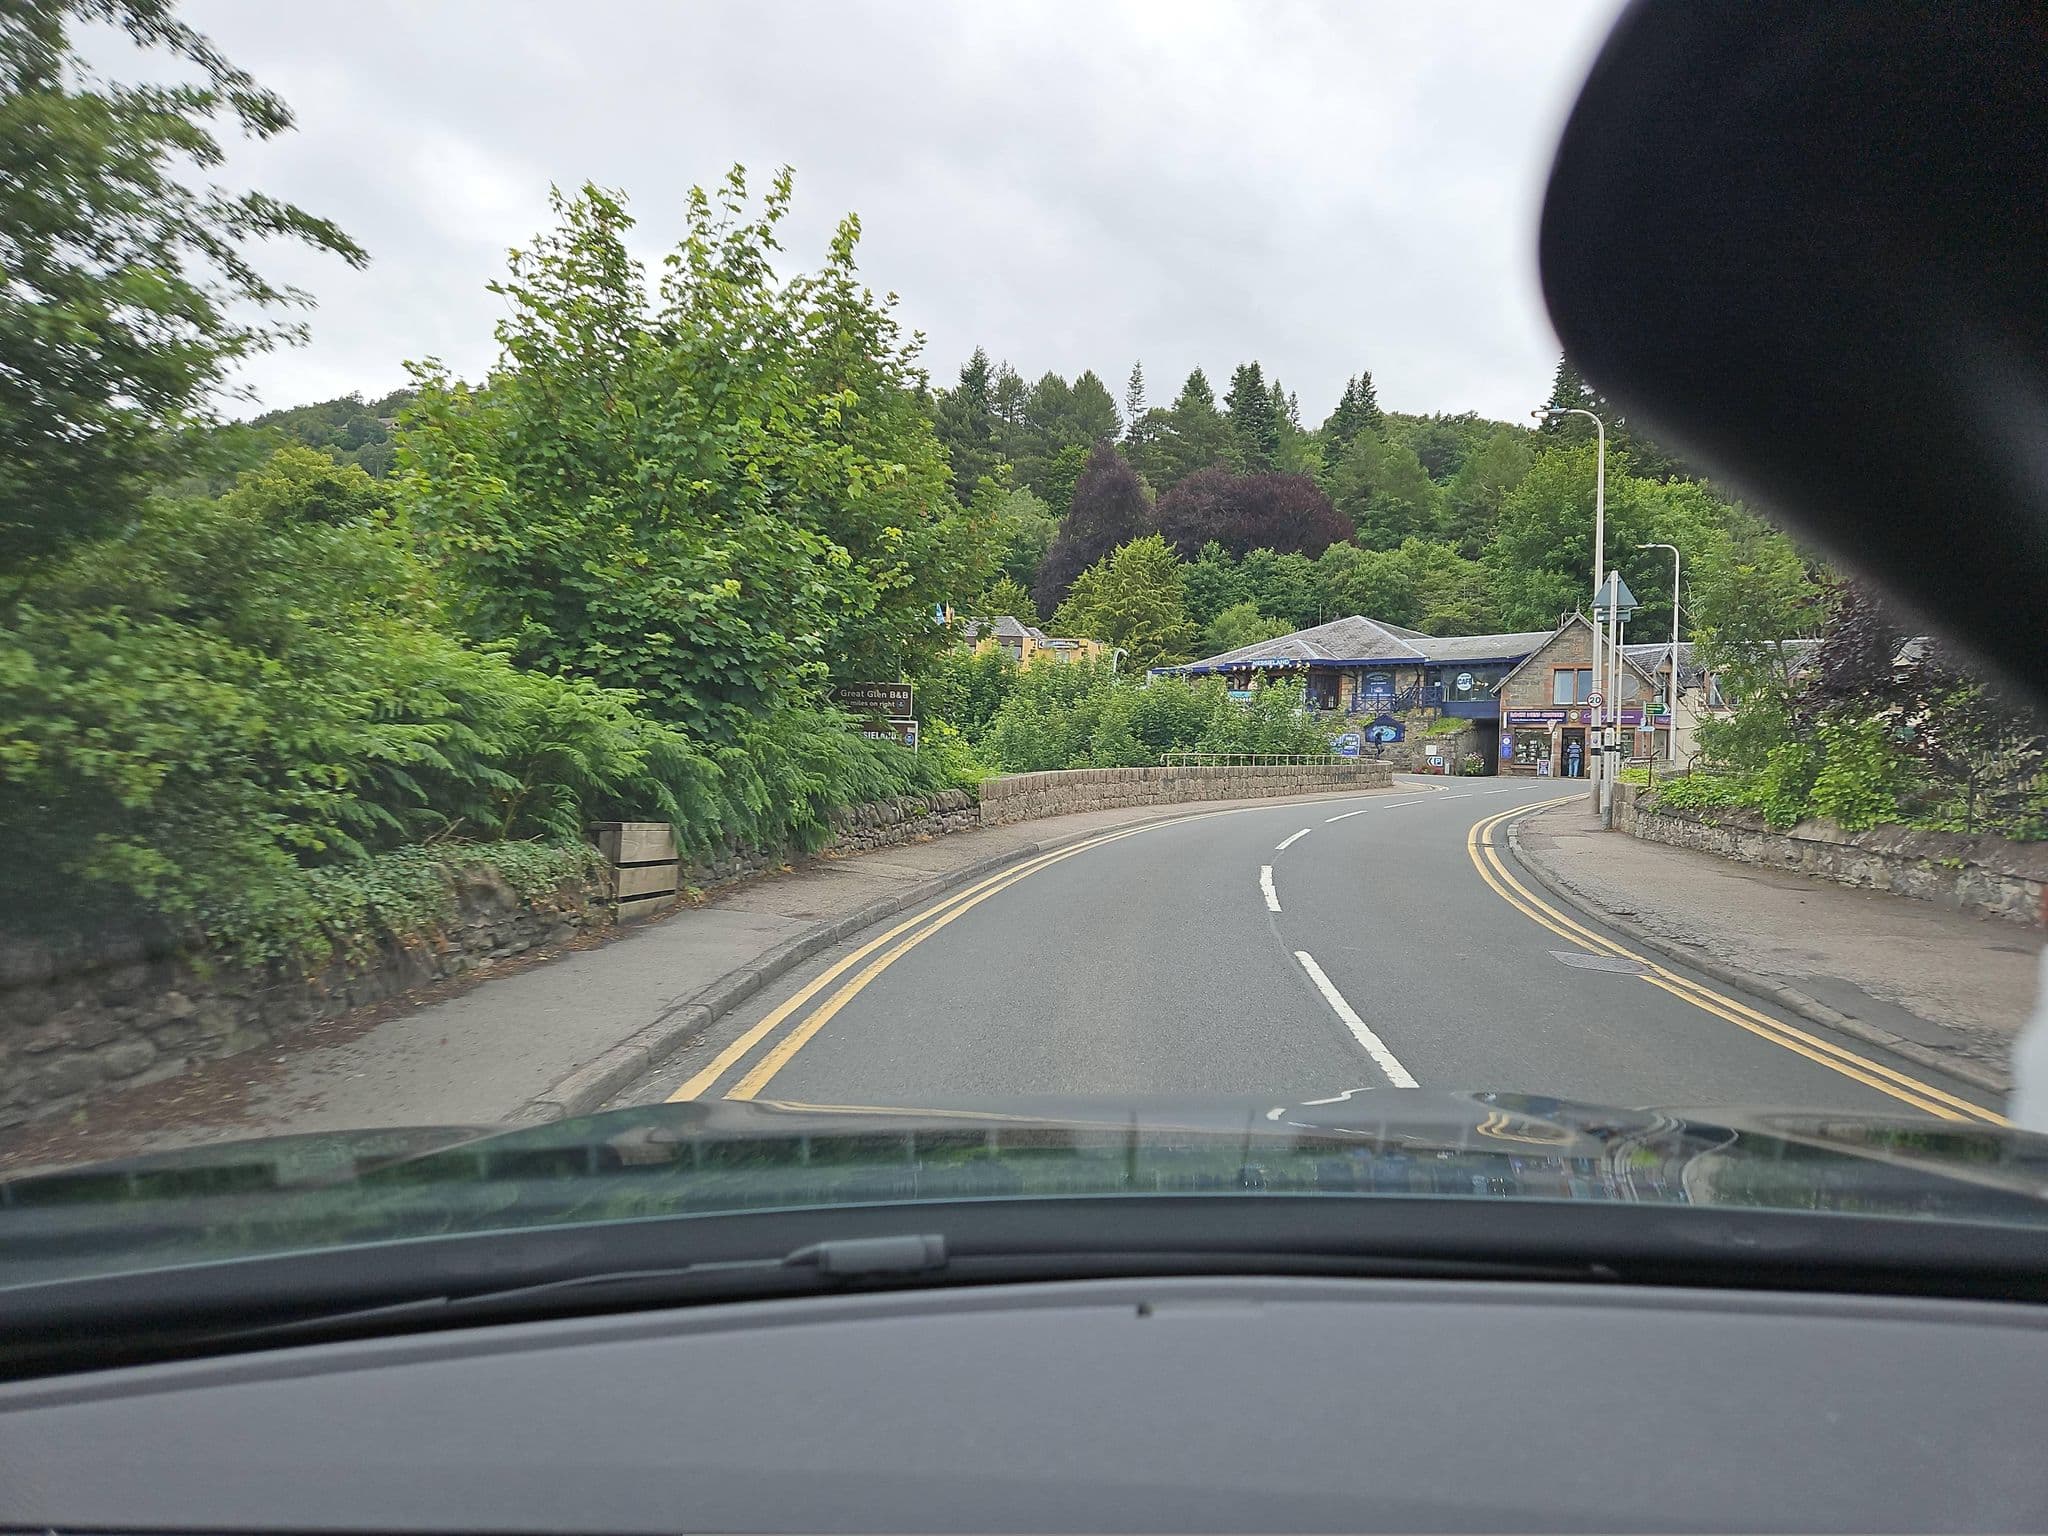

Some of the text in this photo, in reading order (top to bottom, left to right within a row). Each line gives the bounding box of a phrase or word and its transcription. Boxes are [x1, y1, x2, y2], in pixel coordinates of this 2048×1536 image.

[840, 690, 909, 699] Great Glen B&B
[1589, 696, 1601, 704] 20
[879, 701, 896, 709] right
